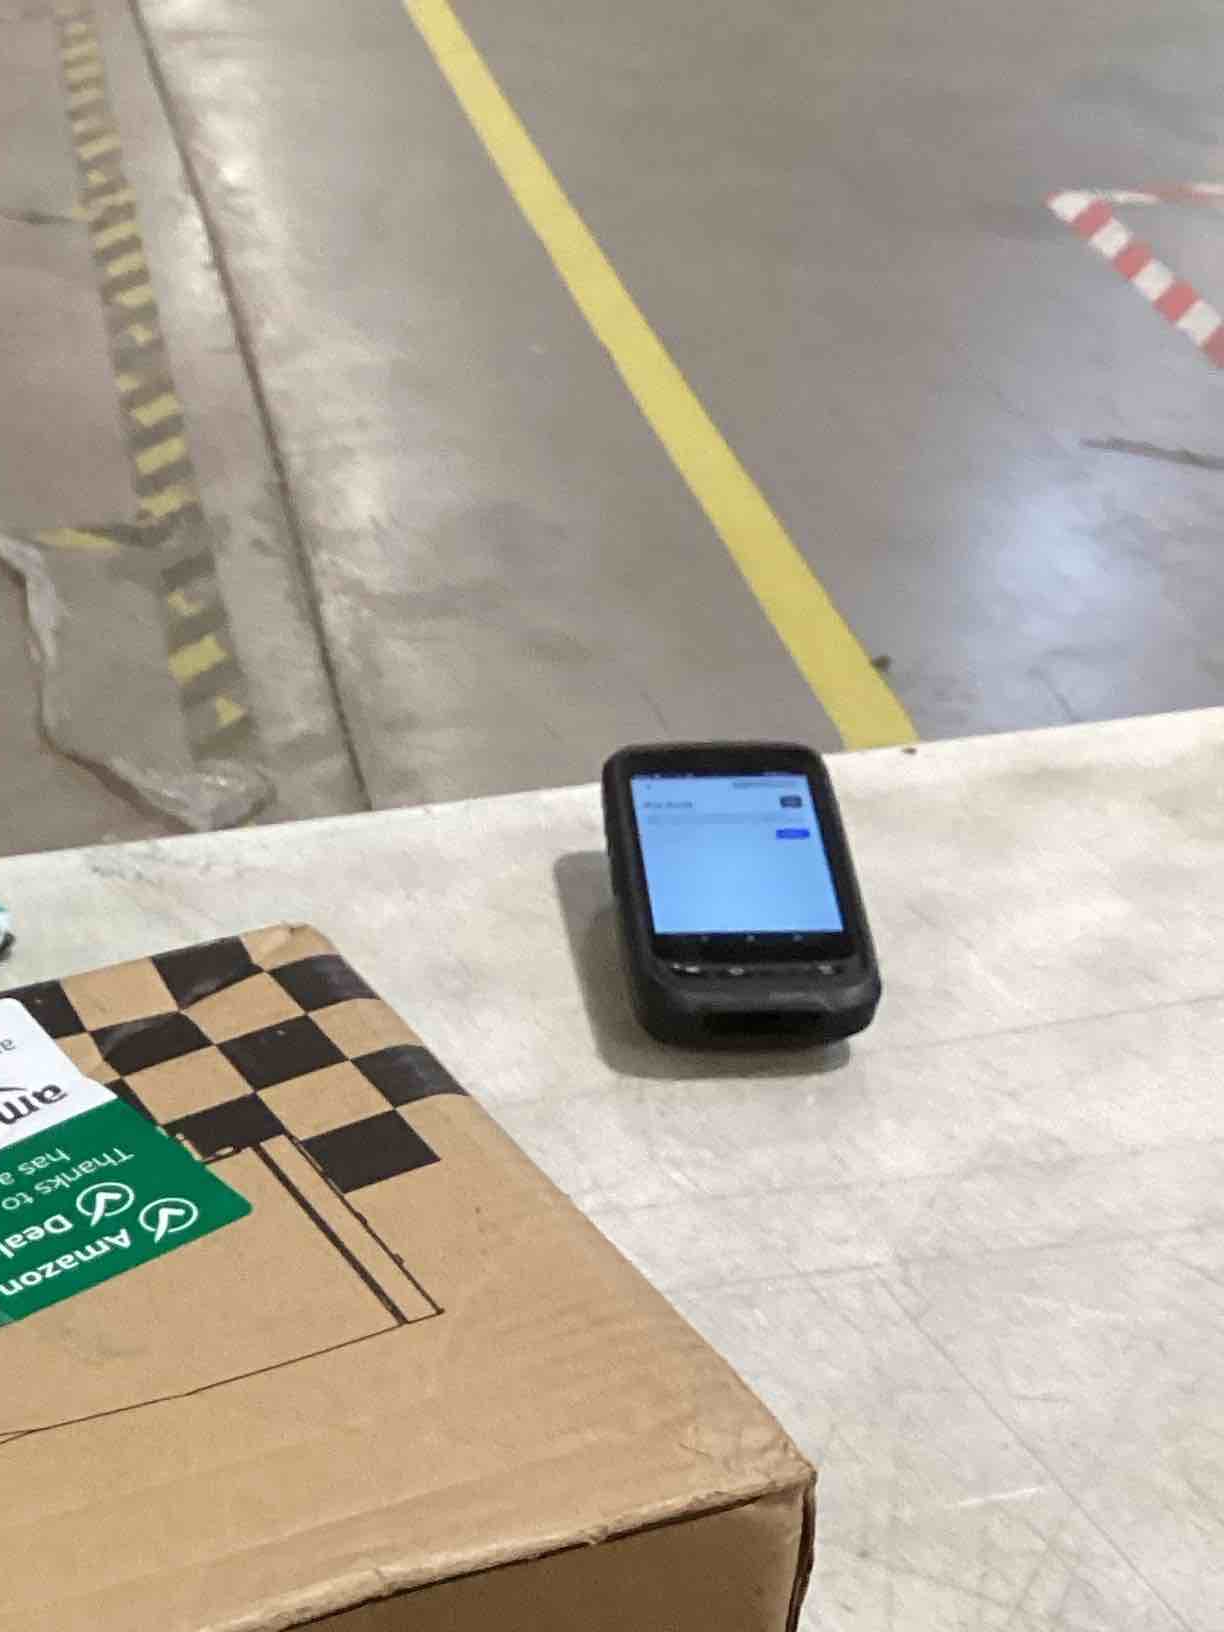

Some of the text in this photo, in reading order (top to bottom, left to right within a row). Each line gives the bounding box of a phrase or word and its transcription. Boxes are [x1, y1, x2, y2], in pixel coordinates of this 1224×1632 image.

[18, 1148, 73, 1175] has
[34, 1148, 136, 1195] Thanks
[1, 1191, 34, 1211] to
